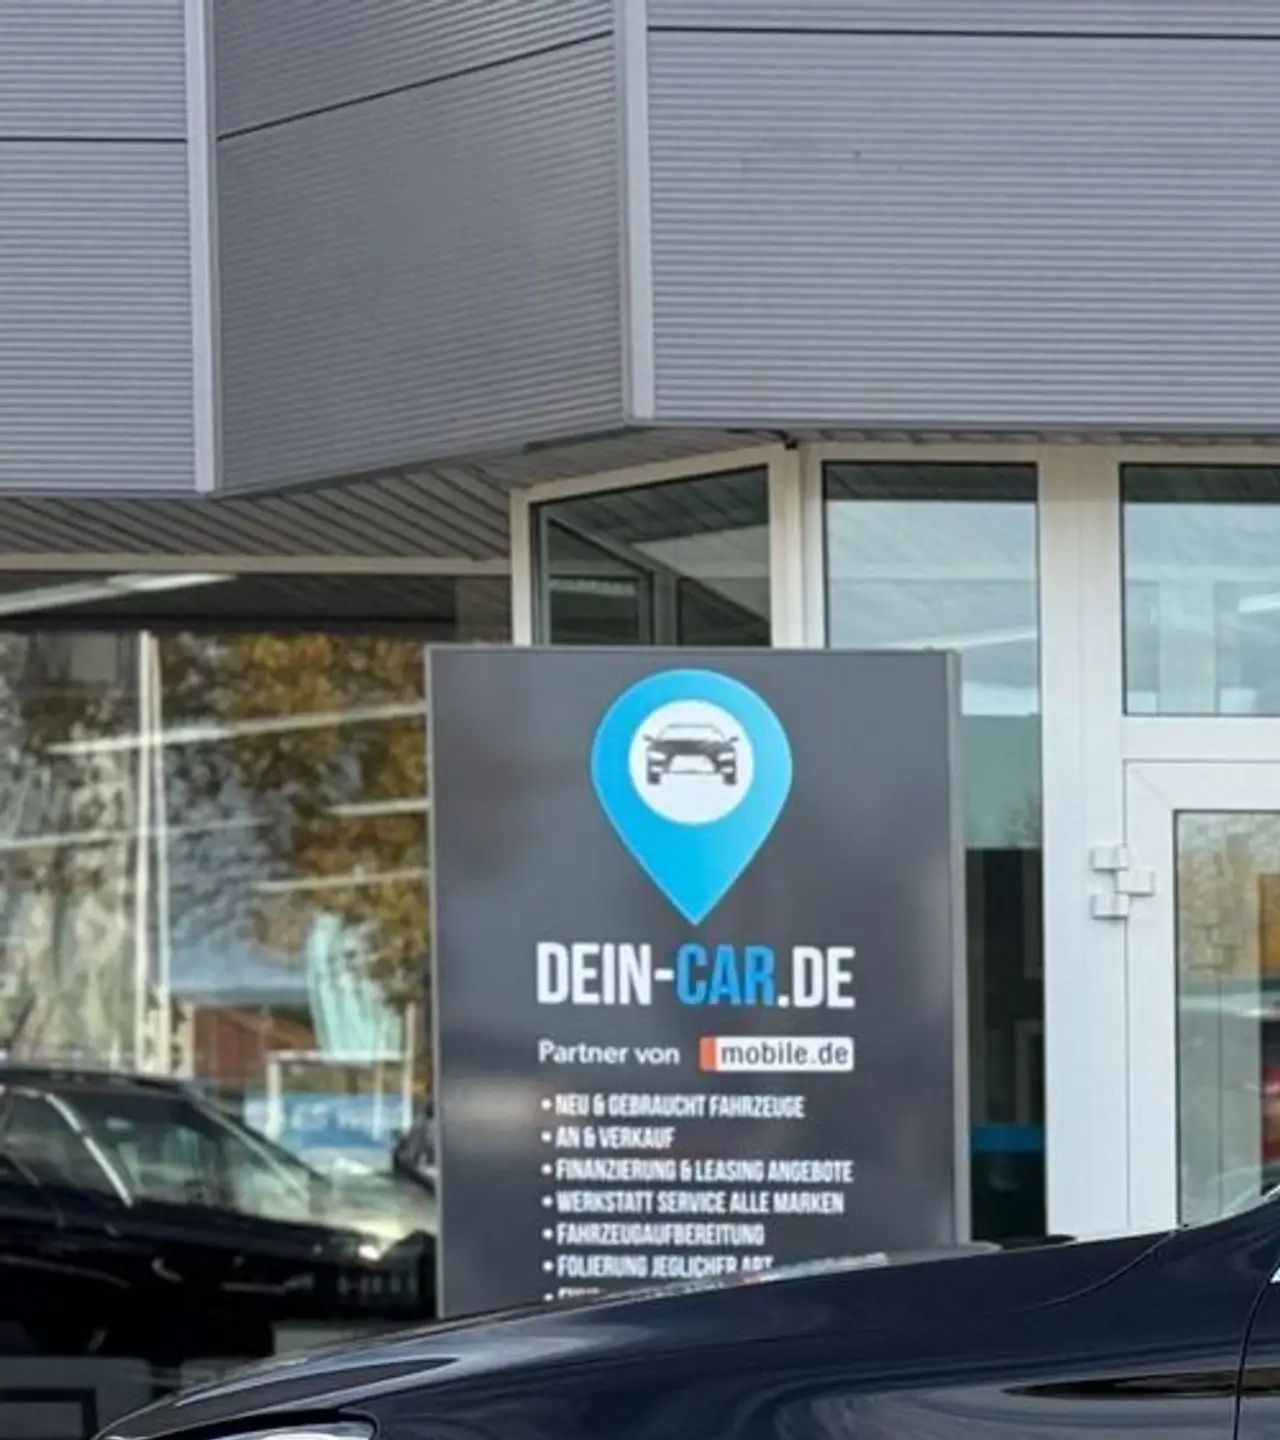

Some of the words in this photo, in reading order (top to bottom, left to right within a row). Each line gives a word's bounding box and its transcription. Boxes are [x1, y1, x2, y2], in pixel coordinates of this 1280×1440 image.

[536, 941, 855, 1008] DEIN-CAR.DE
[537, 1039, 627, 1064] Partner
[634, 1047, 680, 1065] von
[720, 1042, 849, 1065] mobile.de
[555, 1093, 589, 1116] NEU
[593, 1094, 605, 1116] &
[608, 1094, 706, 1117] GEBRAUCHT
[709, 1095, 805, 1118] FAHRZEUGE
[555, 1126, 580, 1148] AN
[583, 1126, 596, 1148] &
[599, 1126, 676, 1148] VERKAUF
[555, 1159, 676, 1182] FINANZIERUNG
[680, 1160, 692, 1182] &
[695, 1160, 764, 1182] LEASING
[767, 1160, 854, 1183] ANGEBOTE
[557, 1190, 654, 1213] WERKSTATT
[657, 1191, 725, 1213] SERVICE
[729, 1191, 770, 1213] ALLE
[773, 1192, 845, 1214] MARKEN
[557, 1223, 765, 1246] FAHRZEUGAUFBEREITUNG
[557, 1255, 648, 1278] FOLIERUNG
